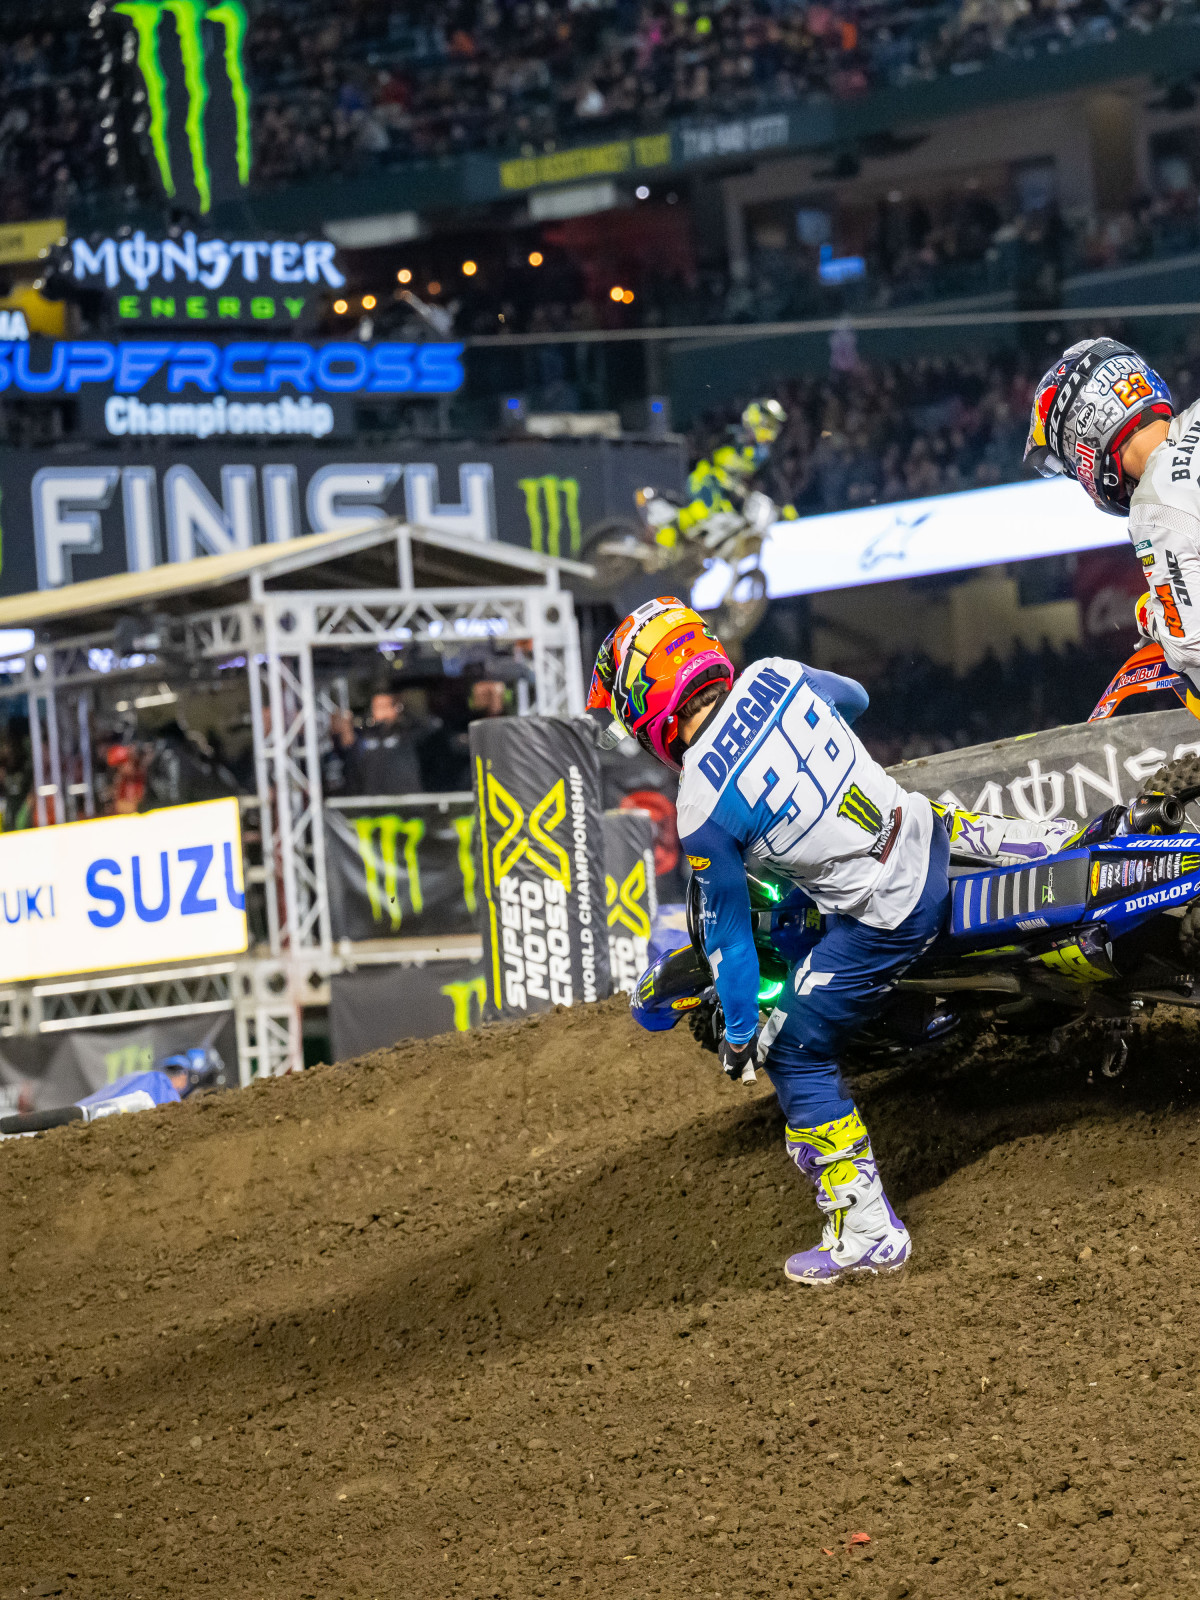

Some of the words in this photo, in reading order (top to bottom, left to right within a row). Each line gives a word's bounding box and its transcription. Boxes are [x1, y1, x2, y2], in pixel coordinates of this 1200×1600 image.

[72, 230, 346, 291] MONSTER
[118, 295, 306, 319] ENERGY
[105, 396, 335, 437] Championship
[1049, 353, 1092, 457] SCOTT
[1112, 372, 1154, 411] 23
[32, 463, 496, 590] FINISH
[697, 667, 791, 793] DEEGAN
[732, 730, 757, 763] DANGER
[733, 680, 857, 858] 38
[569, 765, 593, 926] CHAMPIONSHIP
[1126, 838, 1197, 848] DUNLOP
[0, 885, 55, 923] UKI
[86, 842, 245, 928] SUZU
[1125, 882, 1192, 912] DUNLOP
[500, 875, 527, 1010] SUPER
[520, 880, 550, 1000] MOTO
[543, 877, 573, 1008] CROSS
[1016, 917, 1049, 931] YAMAHA
[579, 928, 598, 1003] WORLD
[615, 936, 637, 997] OTO
